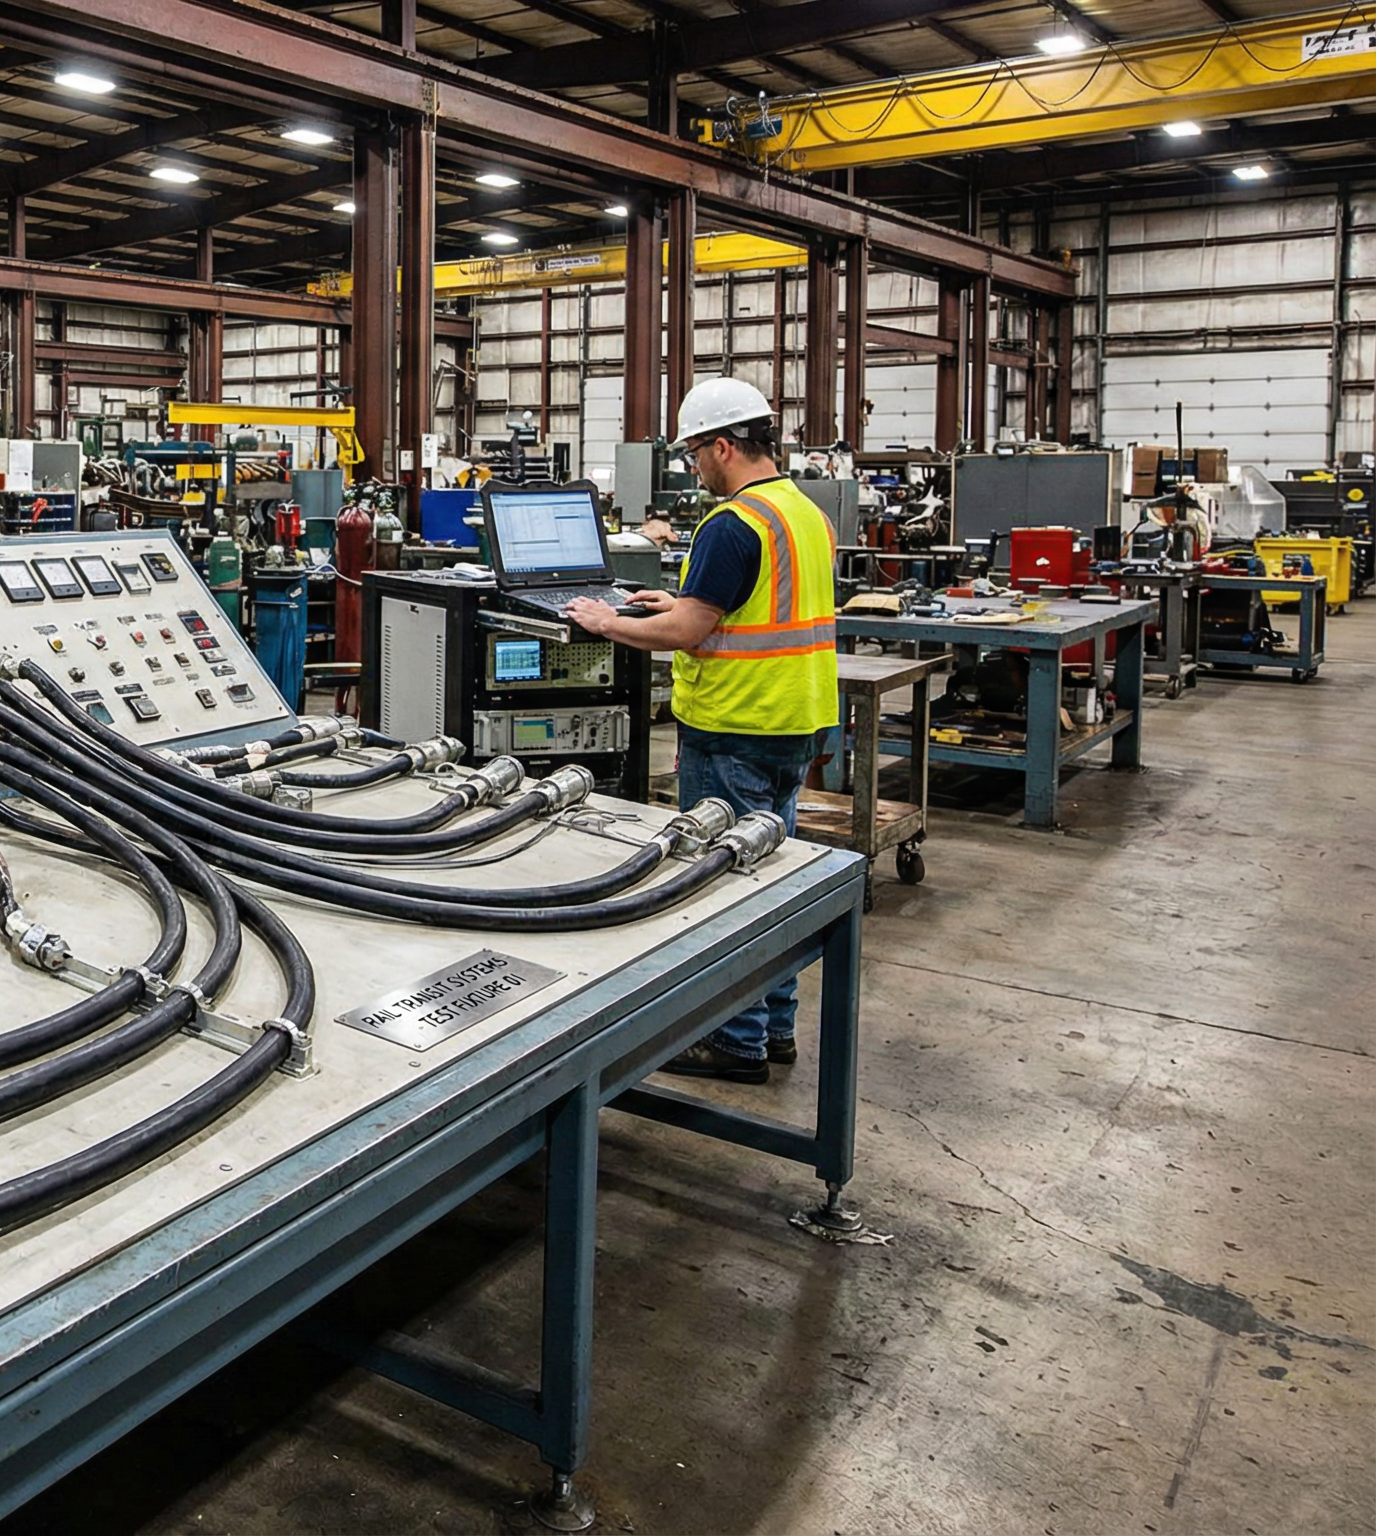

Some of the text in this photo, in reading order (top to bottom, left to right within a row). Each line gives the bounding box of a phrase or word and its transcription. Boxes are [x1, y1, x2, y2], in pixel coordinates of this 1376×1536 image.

[361, 957, 508, 1028] RAIL TRANSIT SYSTEMS
[418, 1005, 460, 1027] TEST
[451, 980, 511, 1011] FIXTURE
